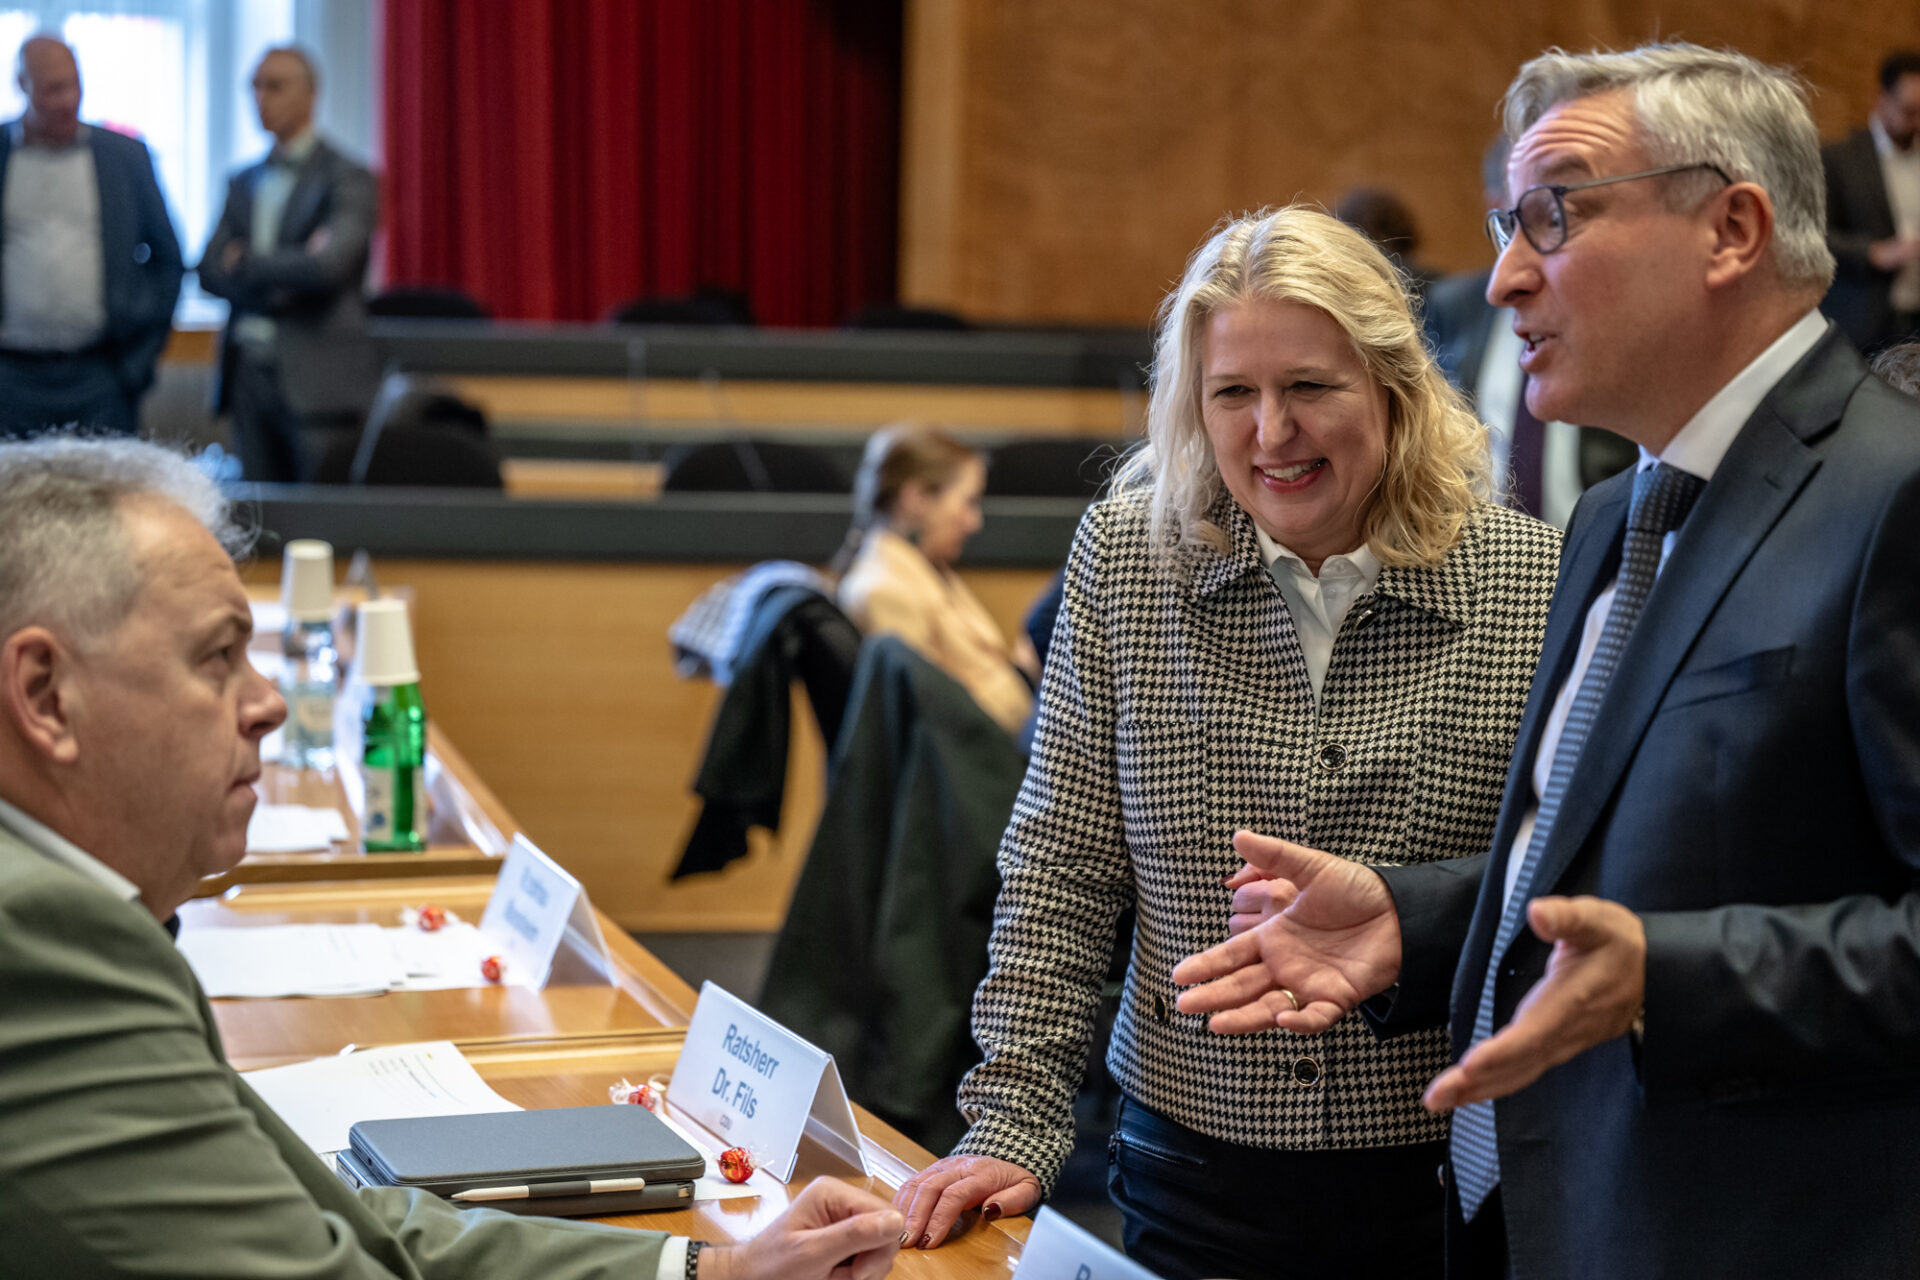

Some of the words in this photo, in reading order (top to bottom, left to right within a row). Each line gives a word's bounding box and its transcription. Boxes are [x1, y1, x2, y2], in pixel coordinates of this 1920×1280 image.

[722, 1023, 779, 1079] Ratsherr
[712, 1067, 731, 1102] Dr.
[732, 1081, 757, 1118] Fils
